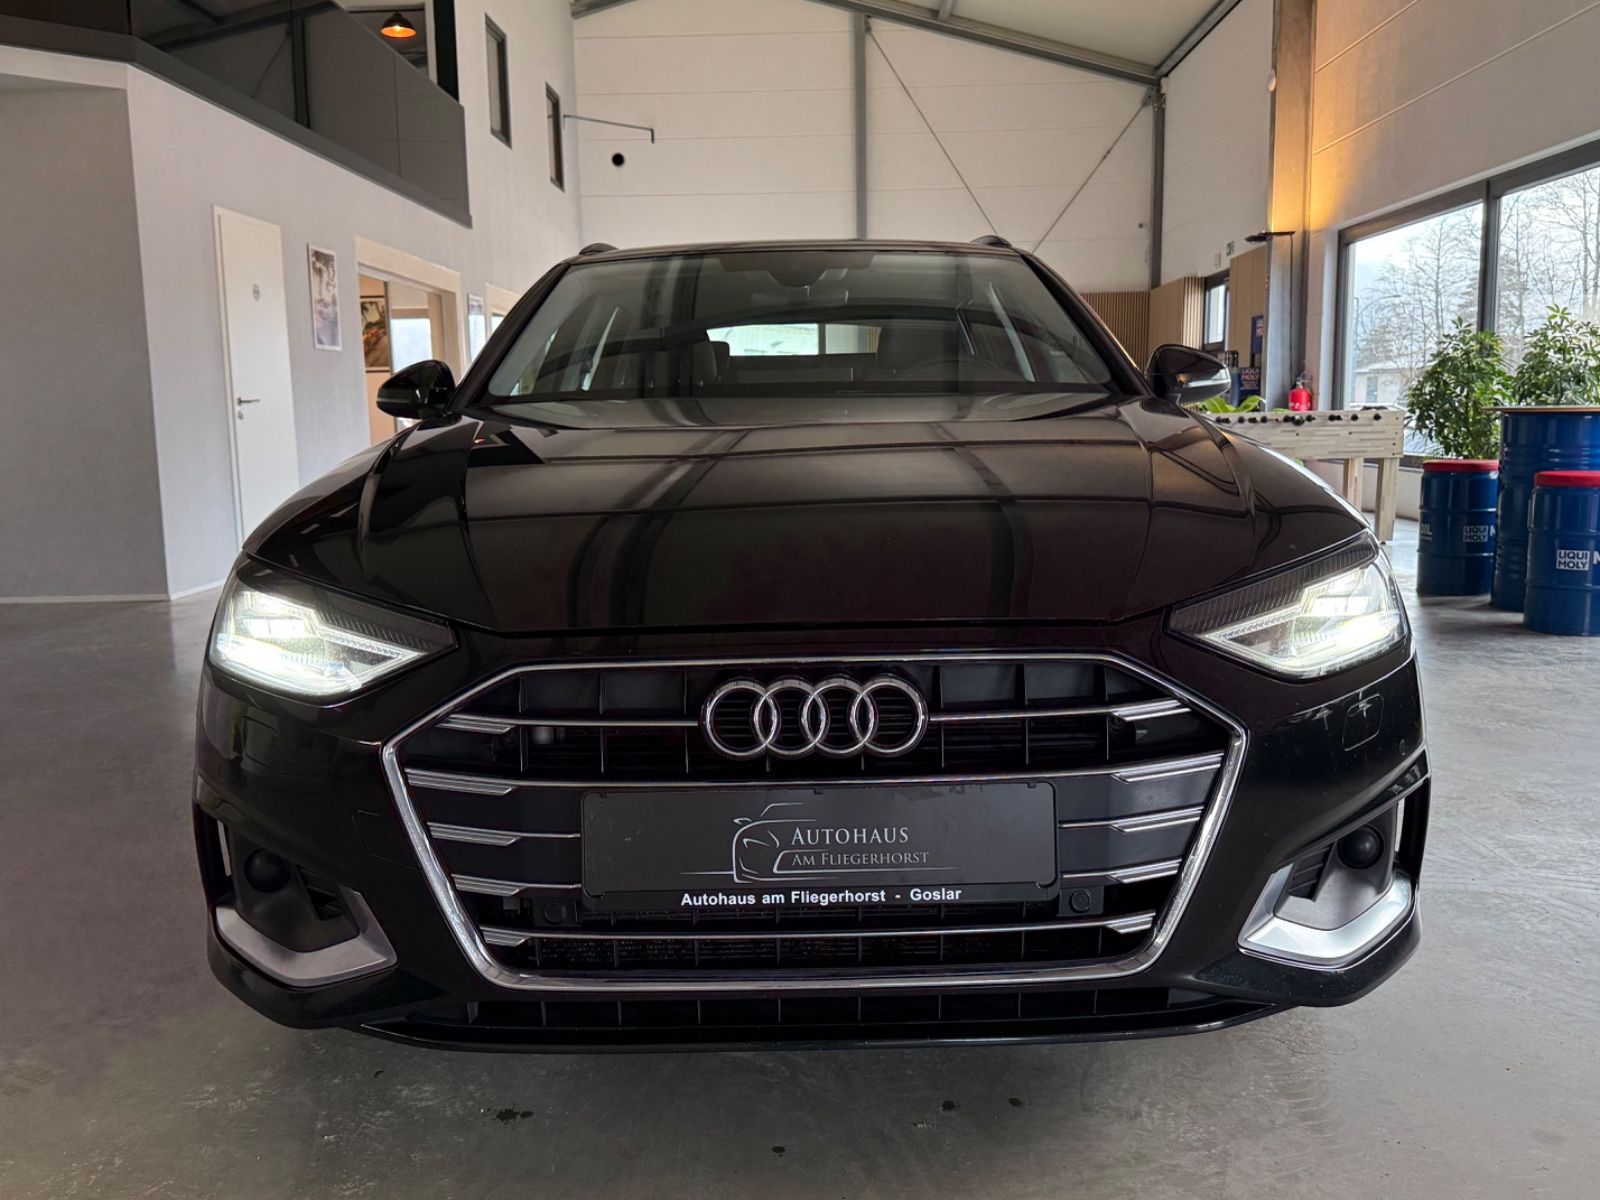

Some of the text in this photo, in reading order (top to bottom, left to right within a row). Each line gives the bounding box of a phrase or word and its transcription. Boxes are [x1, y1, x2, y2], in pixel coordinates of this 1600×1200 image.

[1558, 551, 1588, 560] LIQUI
[1558, 560, 1588, 569] MOLY
[791, 827, 909, 846] AUTOHAUS
[791, 852, 930, 866] AM FLIEGERHORST
[681, 893, 756, 906] Autohaus
[762, 894, 785, 904] am
[791, 890, 886, 906] Fliegerhorst
[910, 887, 962, 900] Goslar
